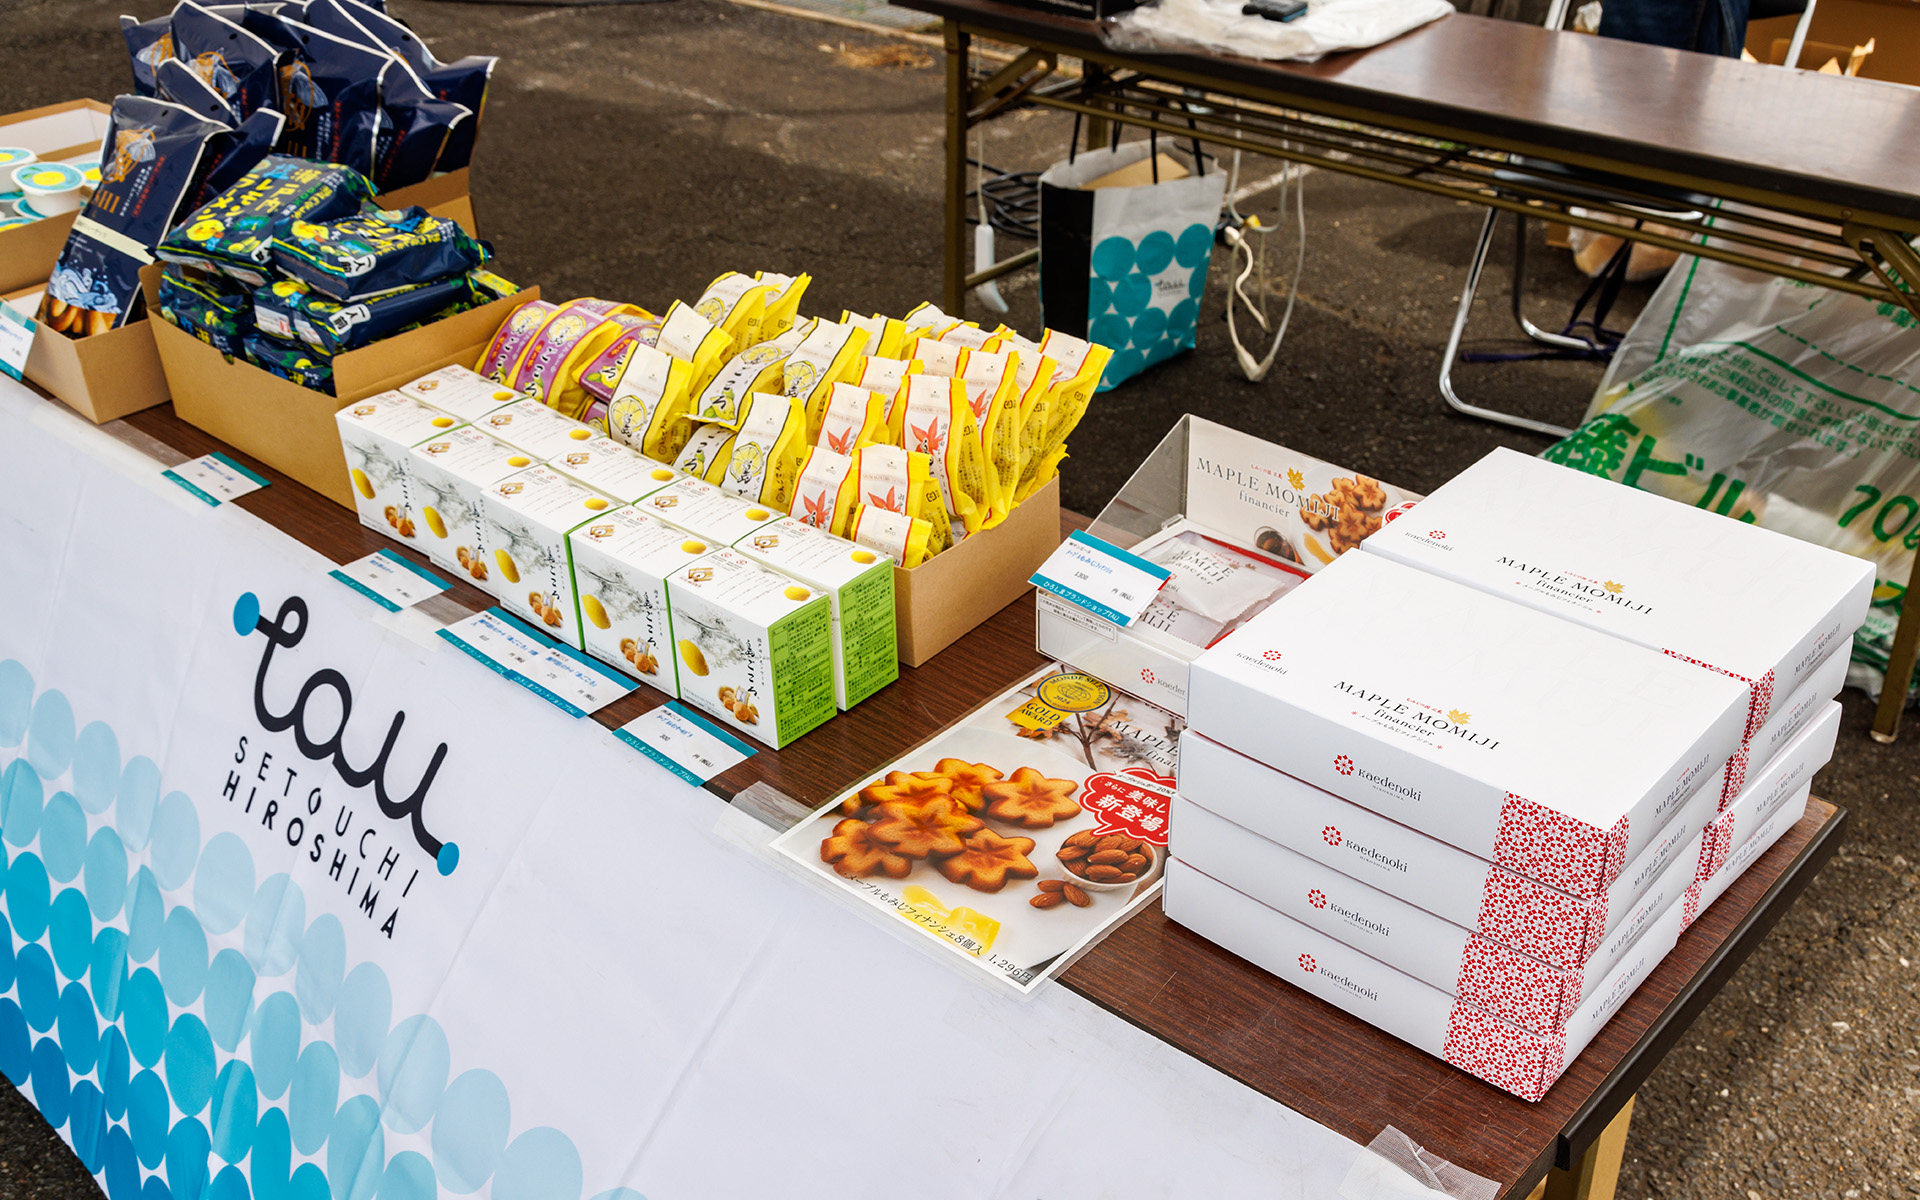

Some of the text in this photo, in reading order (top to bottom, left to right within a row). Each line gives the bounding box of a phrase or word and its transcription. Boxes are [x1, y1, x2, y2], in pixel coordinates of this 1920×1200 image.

[1196, 457, 1341, 522] MAPLE MOMIJI
[1238, 489, 1290, 519] financier
[1495, 555, 1655, 615] MAPLE MOMIJI
[1535, 578, 1595, 604] financier
[1049, 674, 1084, 686] MONDE
[1018, 707, 1053, 727] AWARD
[1025, 701, 1062, 722] GOLD
[1332, 681, 1502, 751] MAPLE MOMIJI
[1373, 708, 1436, 738] financier
[252, 594, 450, 864] tau
[1109, 720, 1178, 757] MAPLE
[1104, 781, 1166, 814] さらに 美味し
[234, 735, 419, 899] SETOUCHI
[222, 769, 400, 940] HIROSHIMA
[988, 953, 1034, 983] 1,296円
